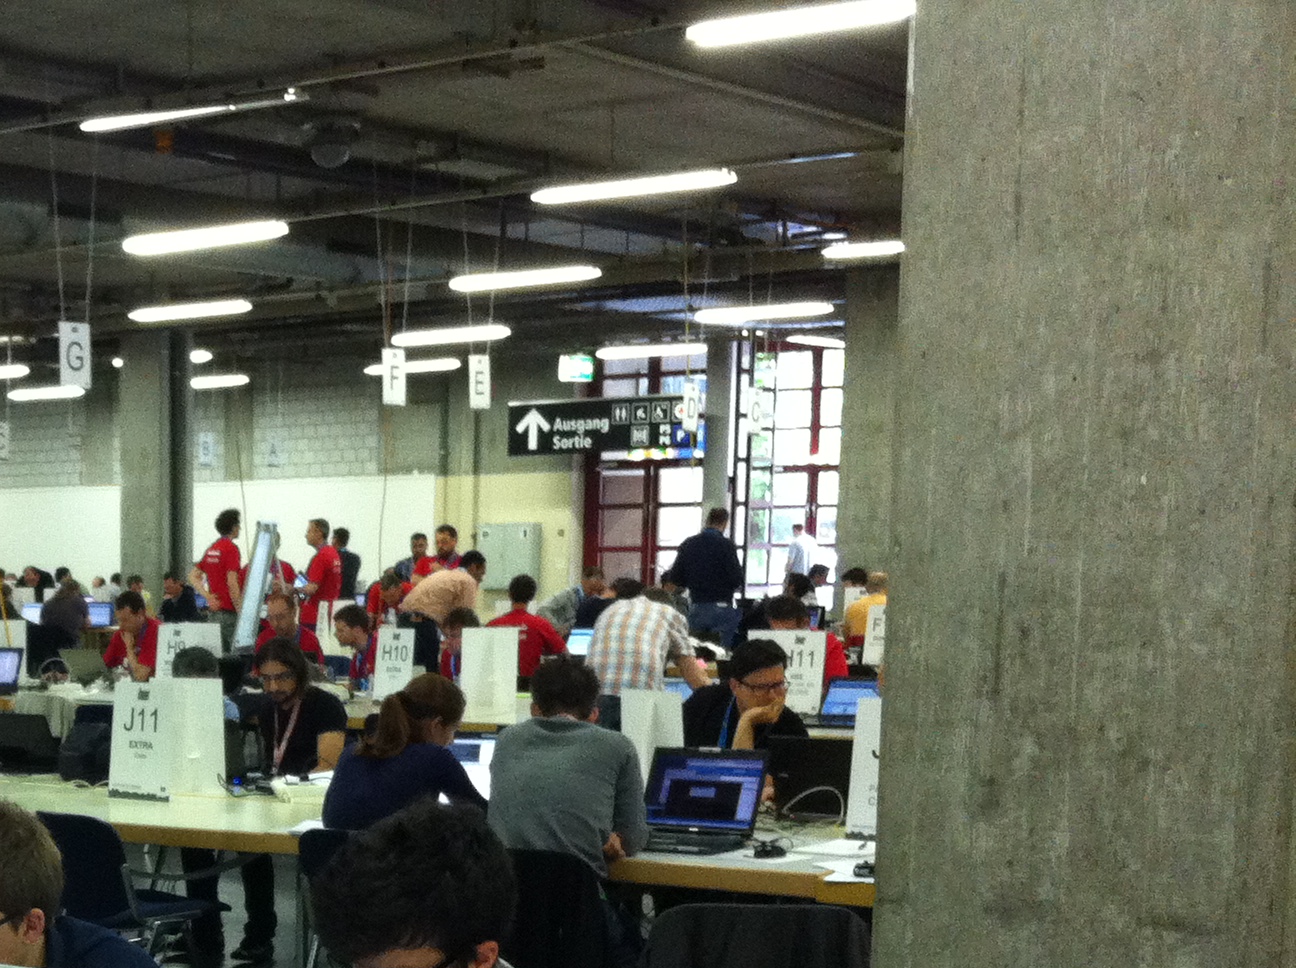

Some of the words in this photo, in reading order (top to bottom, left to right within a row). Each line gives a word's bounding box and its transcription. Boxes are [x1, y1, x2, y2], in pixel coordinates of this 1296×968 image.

[66, 341, 84, 371] G
[390, 365, 400, 391] F
[475, 371, 485, 396] E
[686, 400, 696, 419] D
[553, 417, 610, 433] Ausgang
[552, 434, 592, 450] Sortie
[381, 644, 409, 662] H10
[123, 706, 159, 734] J11
